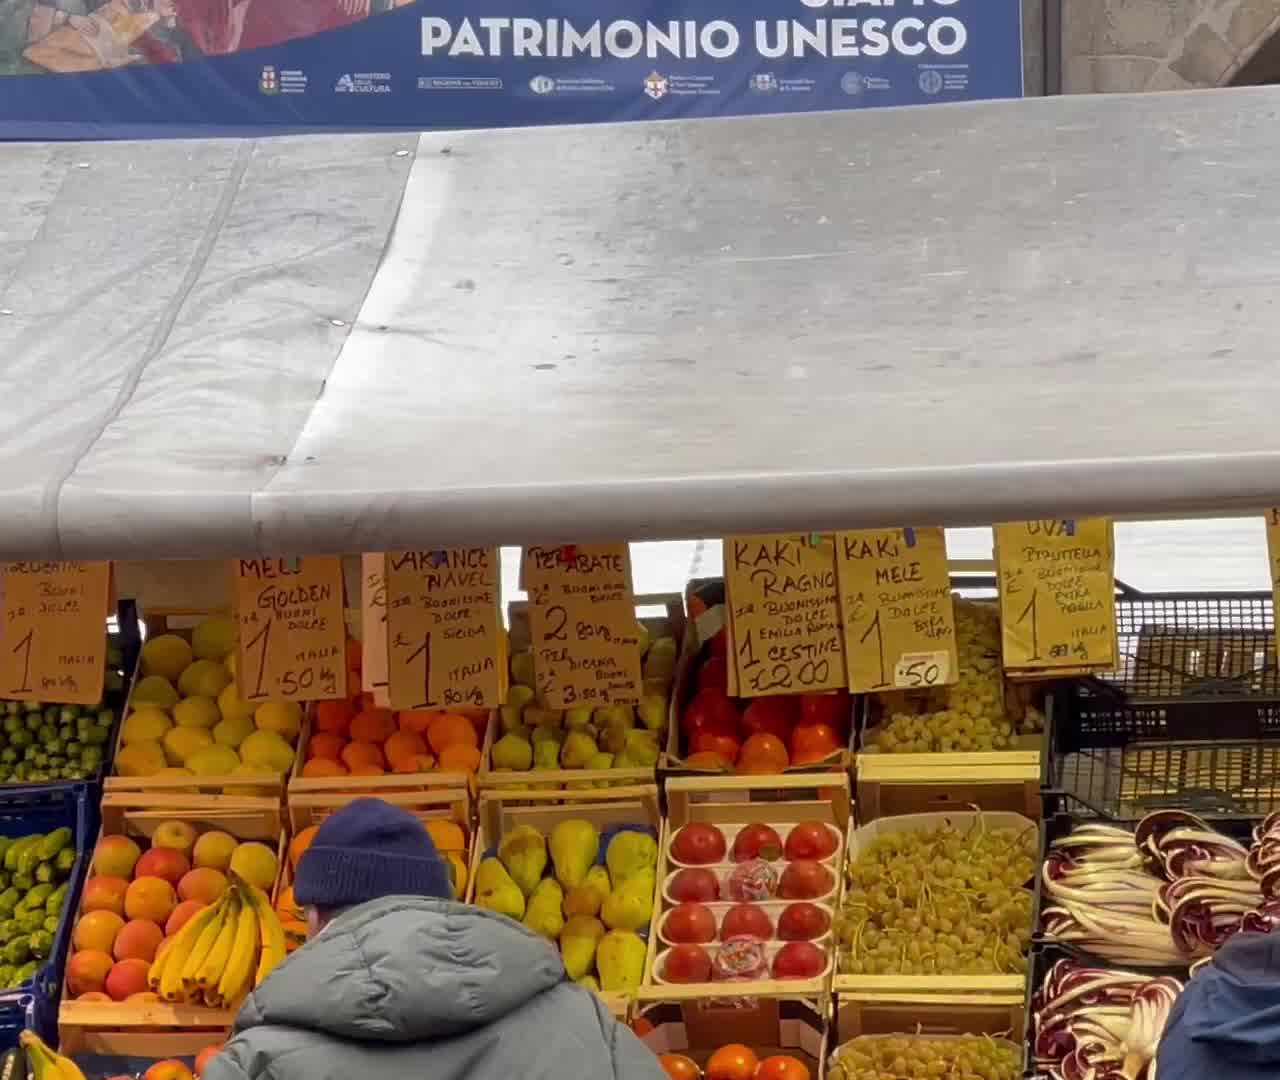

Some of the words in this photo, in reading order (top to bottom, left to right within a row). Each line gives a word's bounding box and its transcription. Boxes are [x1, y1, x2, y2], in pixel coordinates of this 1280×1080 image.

[420, 17, 740, 59] PATRIMONIO
[755, 16, 968, 58] UNESCO
[426, 571, 495, 592] NAVEL
[750, 569, 835, 597] RAGNO
[875, 561, 924, 585] MELE
[256, 584, 332, 610] GOLDEN
